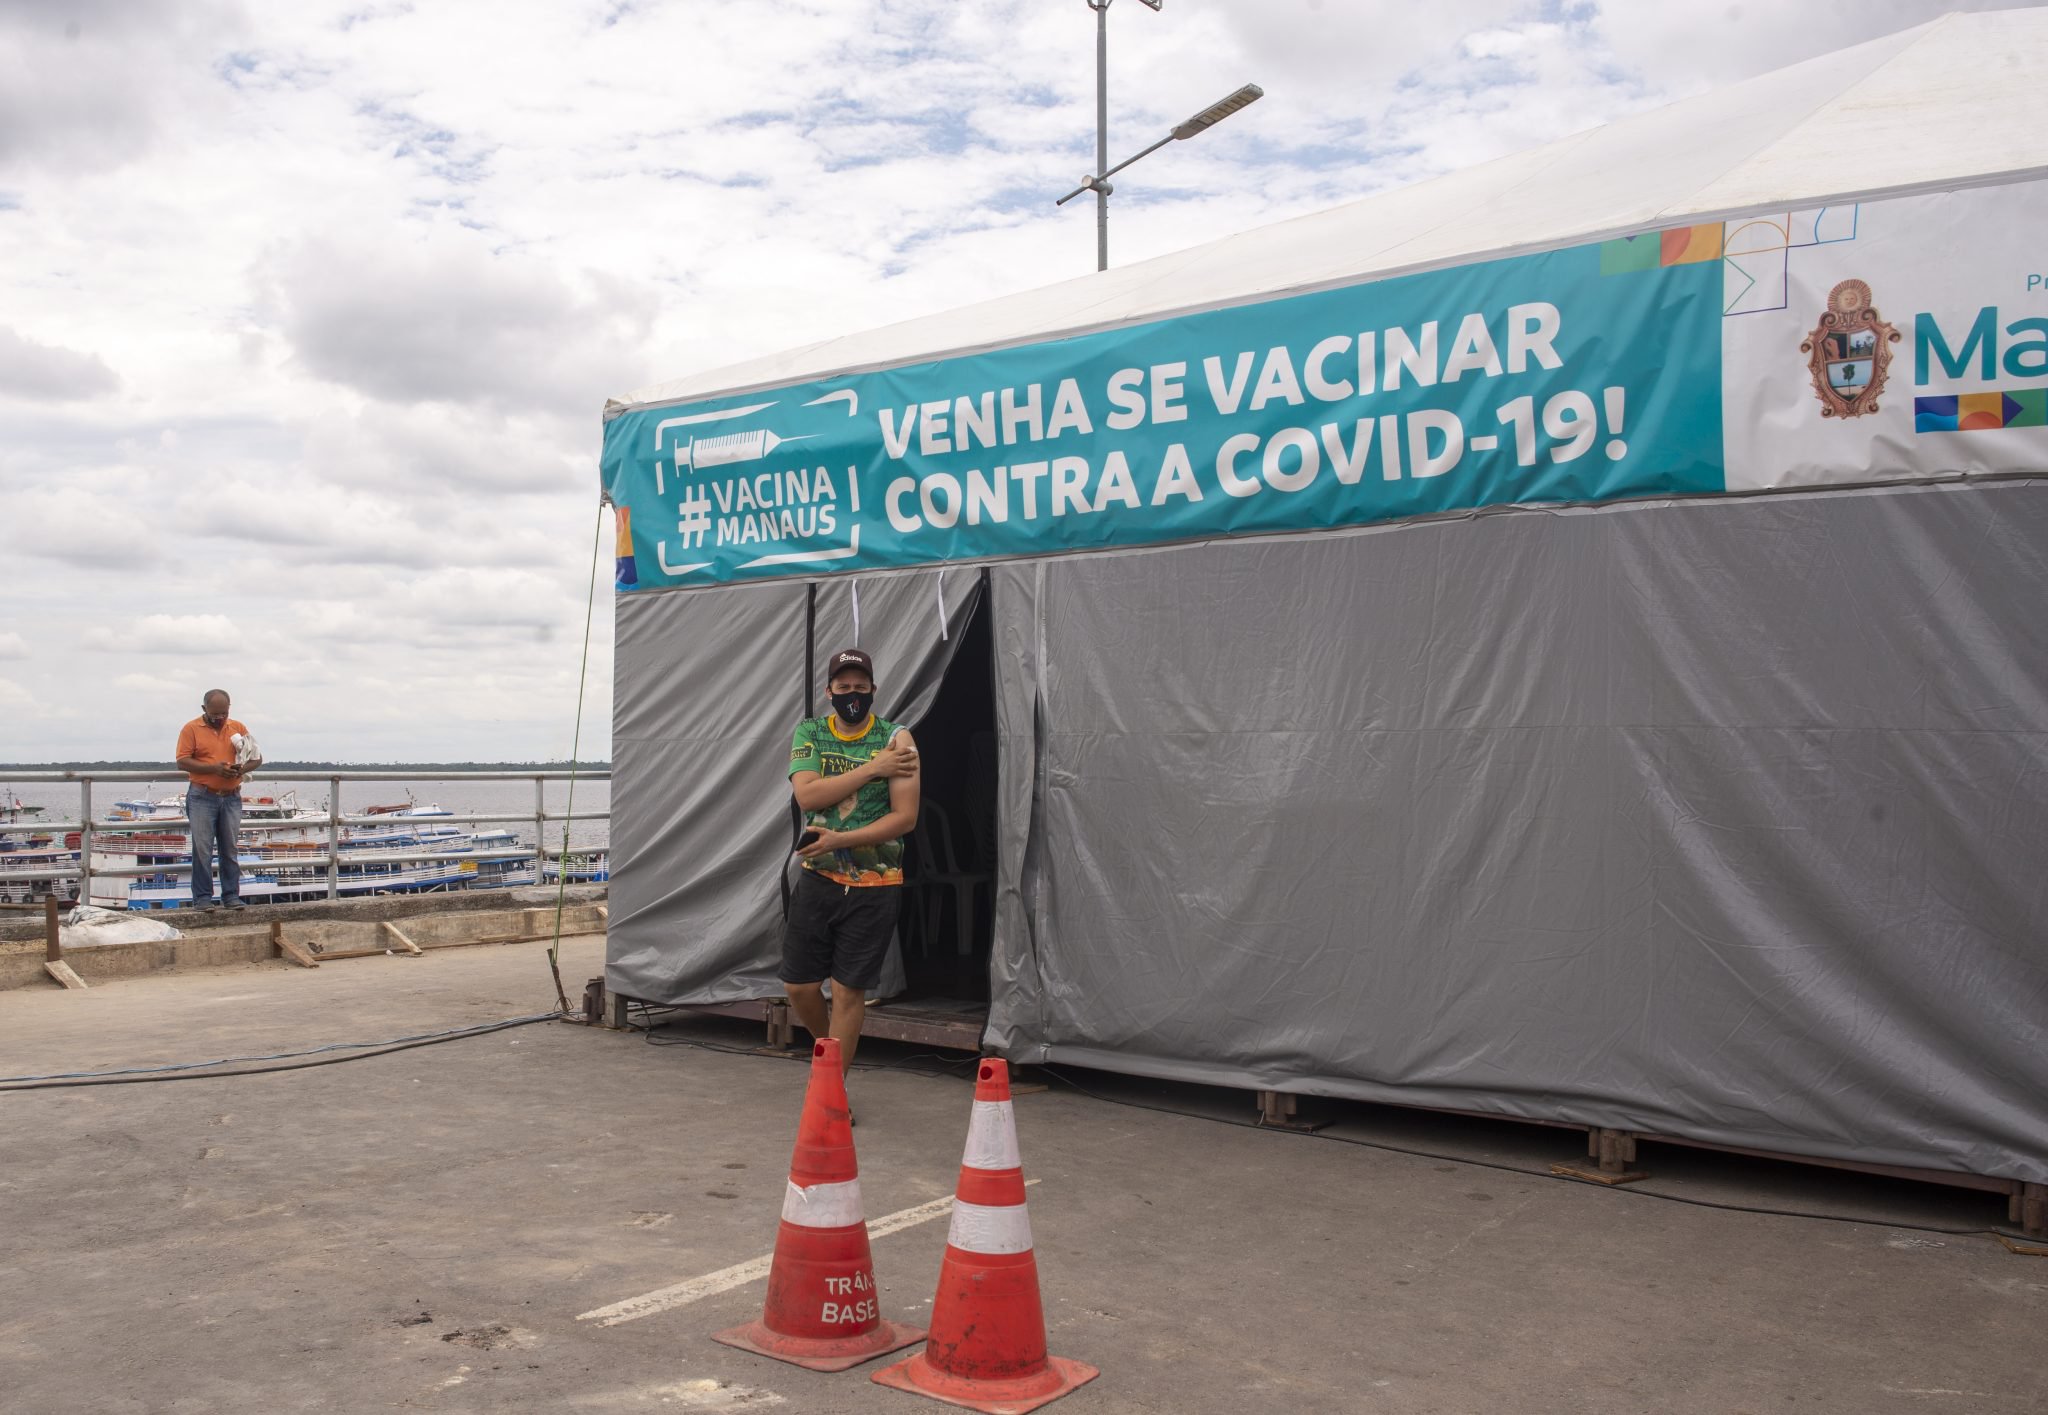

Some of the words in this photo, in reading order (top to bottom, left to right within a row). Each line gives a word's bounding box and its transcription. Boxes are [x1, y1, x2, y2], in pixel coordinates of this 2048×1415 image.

[1914, 305, 2048, 386] Ma
[878, 378, 1094, 460] VENHA
[1106, 361, 1188, 430] SE
[1203, 301, 1564, 415] VACINAR
[885, 451, 1142, 534] CONTRA
[1150, 443, 1204, 506] A
[1215, 386, 1629, 498] COVID-19!
[716, 504, 837, 547] MANAUS
[828, 757, 861, 770] SAMUC
[821, 1299, 876, 1324] BASE
